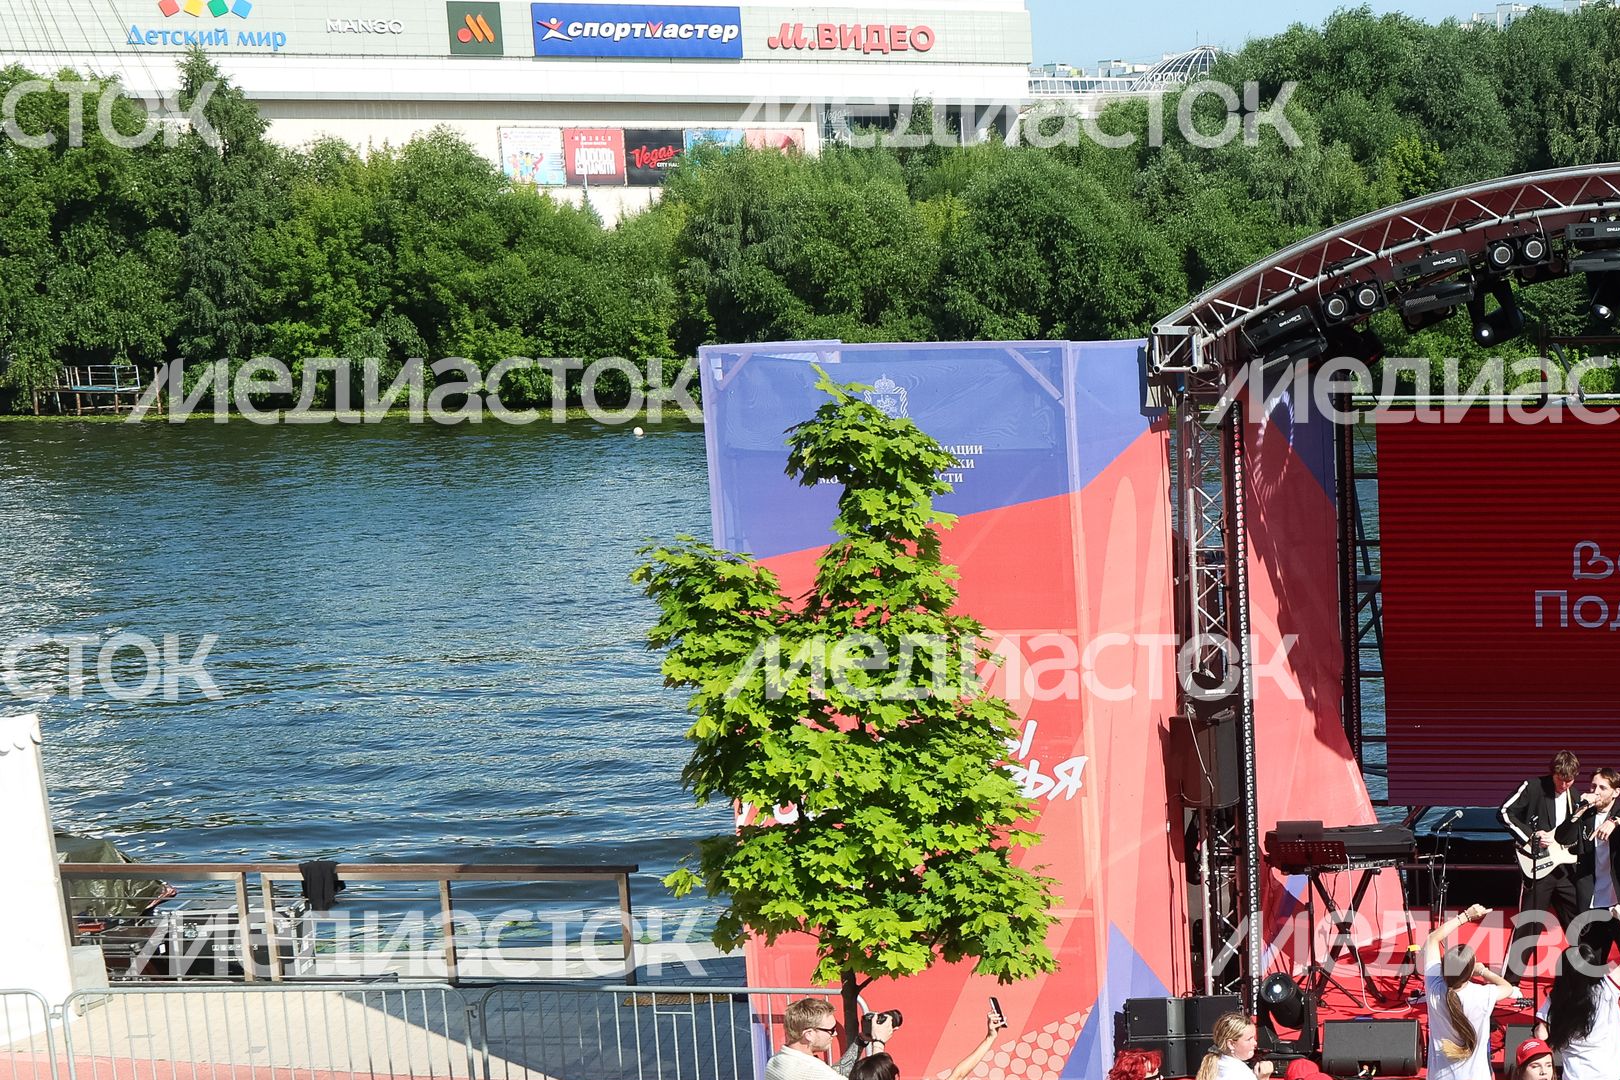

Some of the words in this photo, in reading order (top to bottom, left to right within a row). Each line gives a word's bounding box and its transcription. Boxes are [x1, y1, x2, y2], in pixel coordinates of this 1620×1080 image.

[126, 24, 228, 47] Детский
[237, 29, 287, 51] мир
[326, 18, 405, 35] MANGO
[631, 145, 681, 168] Vegas
